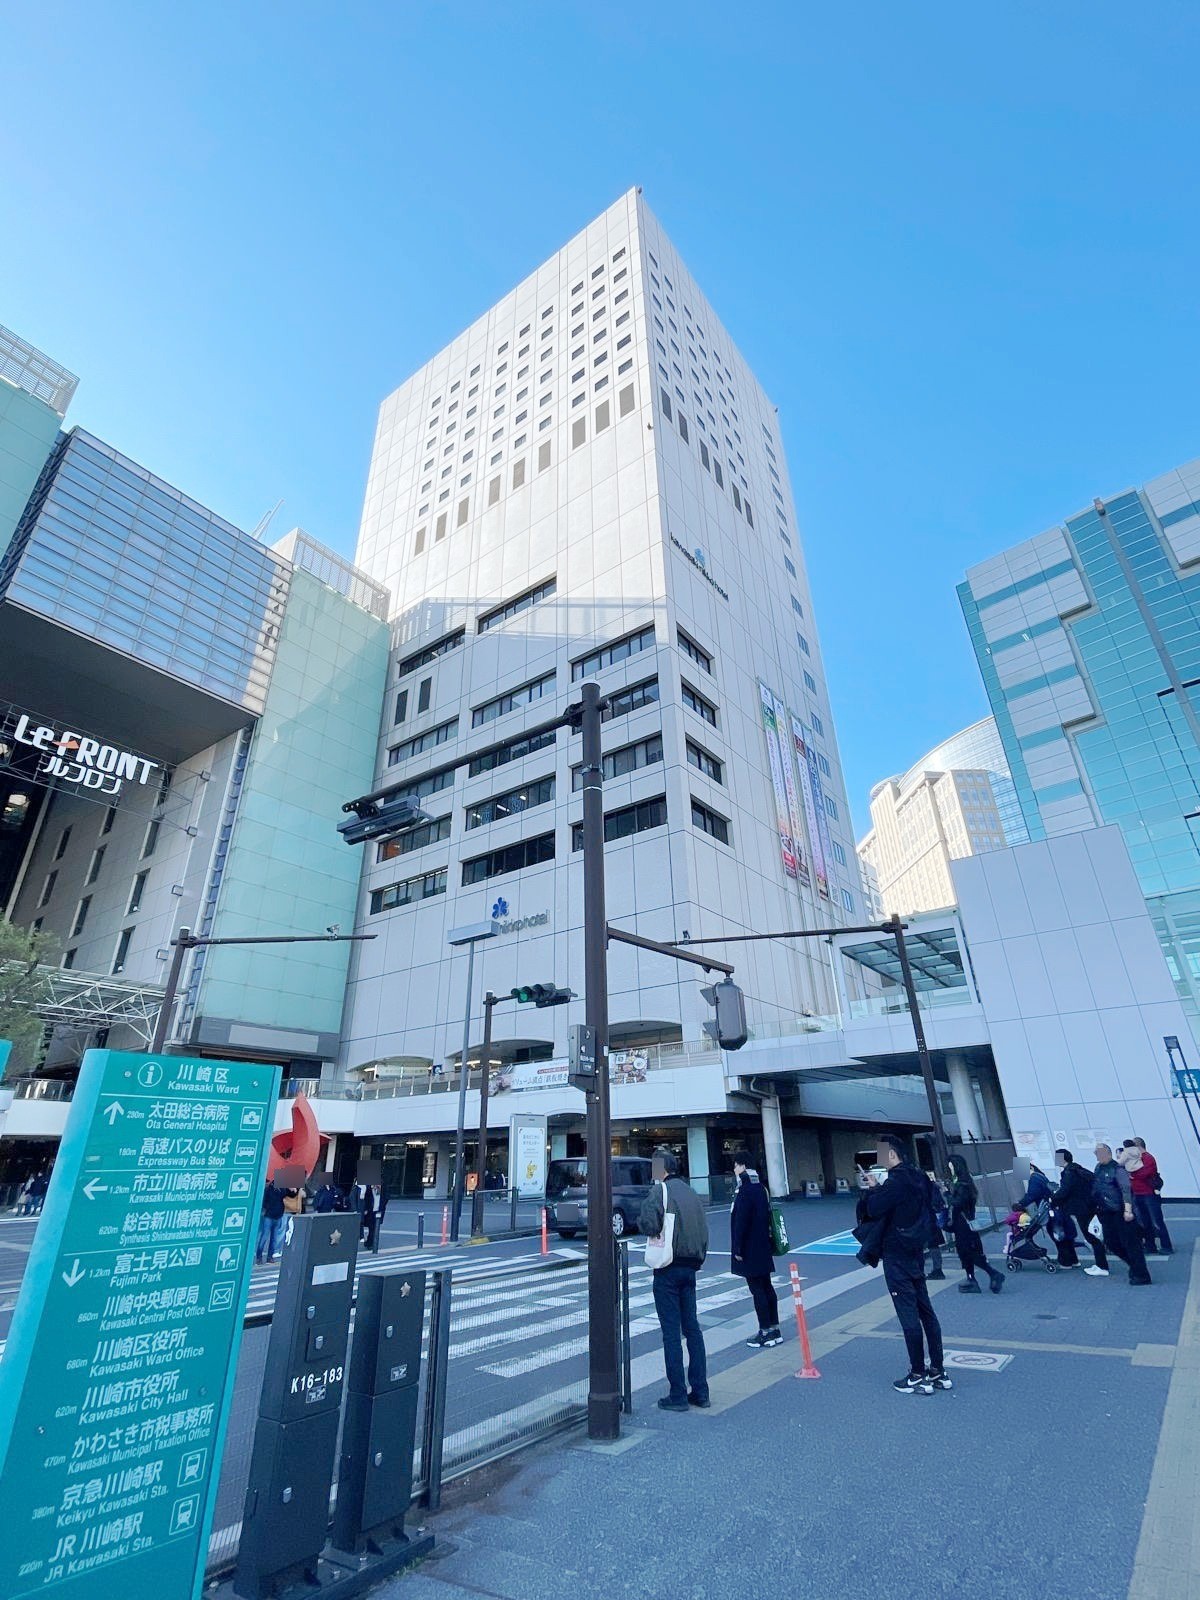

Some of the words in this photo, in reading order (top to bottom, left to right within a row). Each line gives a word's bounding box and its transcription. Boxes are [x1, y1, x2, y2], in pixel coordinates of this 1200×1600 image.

[42, 756, 121, 794] ルフロン
[177, 1064, 230, 1083] 川崎区
[168, 1081, 213, 1093] Kawasaki
[216, 1084, 240, 1094] Ward
[148, 1101, 230, 1121] 太田総合病院
[146, 1120, 161, 1129] Ota
[163, 1120, 194, 1130] General
[196, 1121, 228, 1132] Hospital
[140, 1137, 232, 1155] 高速バスのりば
[137, 1156, 188, 1168] Expressway
[190, 1156, 205, 1166] Bus
[207, 1156, 225, 1168] Stop
[132, 1173, 218, 1192] 市立川崎病院
[129, 1193, 164, 1204] Kawasaki
[164, 1192, 197, 1203] Municipal
[198, 1190, 225, 1202] Hospital
[122, 1208, 214, 1232] 総合新川橋病院
[195, 1227, 219, 1239] Hospital
[89, 1268, 111, 1278] 1.2km
[114, 1246, 203, 1275] 富士見公園
[110, 1273, 139, 1289] Fujimi
[141, 1271, 162, 1284] Park
[103, 1285, 200, 1318] 川崎中央郵便局
[99, 1316, 138, 1331] Kawasaki
[139, 1310, 166, 1325] Central
[166, 1307, 184, 1320] Post
[184, 1305, 206, 1317] Office
[93, 1327, 188, 1363] 川崎区役所
[89, 1357, 143, 1378] Kawasaki
[146, 1351, 173, 1366] Ward
[175, 1346, 205, 1360] Office
[82, 1369, 180, 1411] 川崎市役所
[291, 1366, 344, 1394] K16-183
[55, 1405, 78, 1419] 620m
[79, 1400, 138, 1426] Kawasaki
[141, 1396, 165, 1411] City
[166, 1388, 189, 1405] Hall
[71, 1402, 215, 1459] かわさき市税事務所
[67, 1455, 110, 1476] Kawasaki
[111, 1441, 152, 1462] Municipal
[154, 1434, 187, 1451] Taxation
[188, 1426, 211, 1441] Office
[60, 1460, 164, 1511] 京急川崎駅
[55, 1507, 96, 1528] Keikyu
[97, 1488, 149, 1516] Kawasaki
[150, 1484, 170, 1499] Sta.
[43, 1564, 64, 1583] JR
[67, 1541, 130, 1575] Kawasaki
[132, 1535, 155, 1552] Sta.
